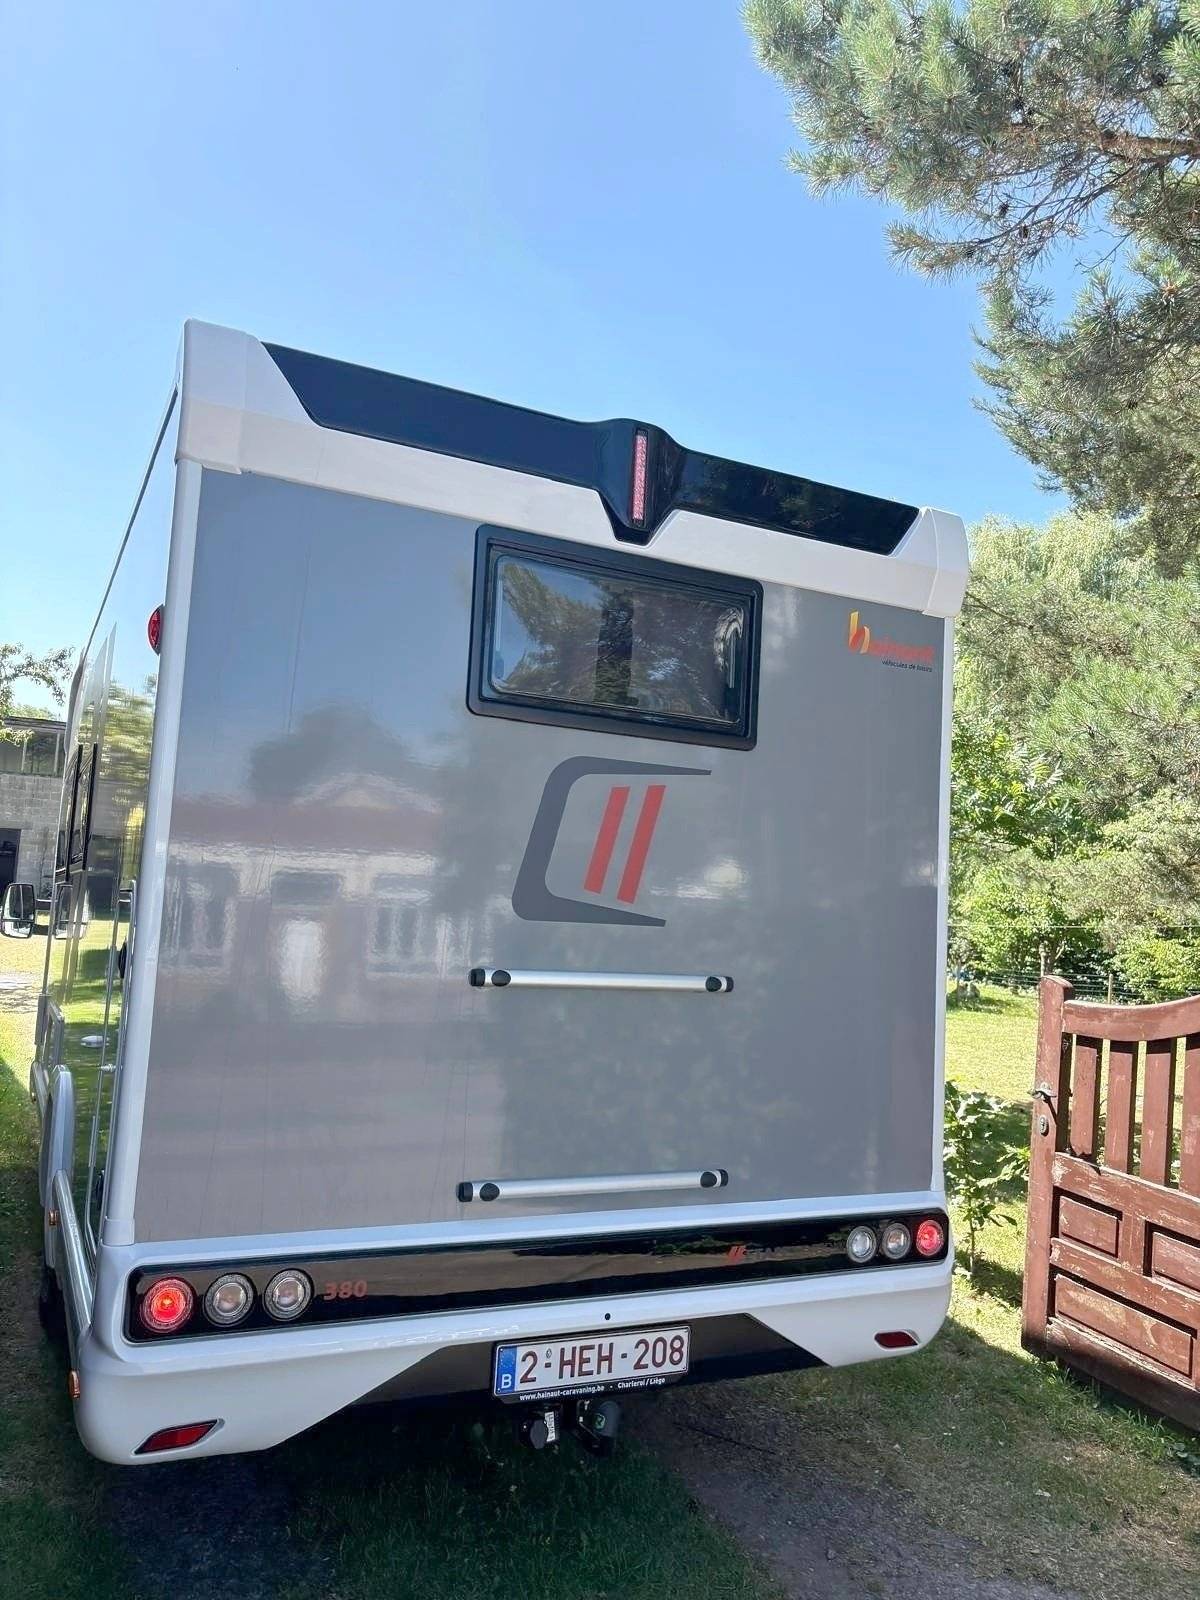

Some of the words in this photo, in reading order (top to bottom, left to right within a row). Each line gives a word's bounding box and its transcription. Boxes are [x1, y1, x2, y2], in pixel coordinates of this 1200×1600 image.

[323, 1280, 368, 1300] 380
[502, 1374, 511, 1389] B
[519, 1334, 685, 1383] 2-HEH-208
[519, 1385, 605, 1401] www.hainaut-caravaning.be
